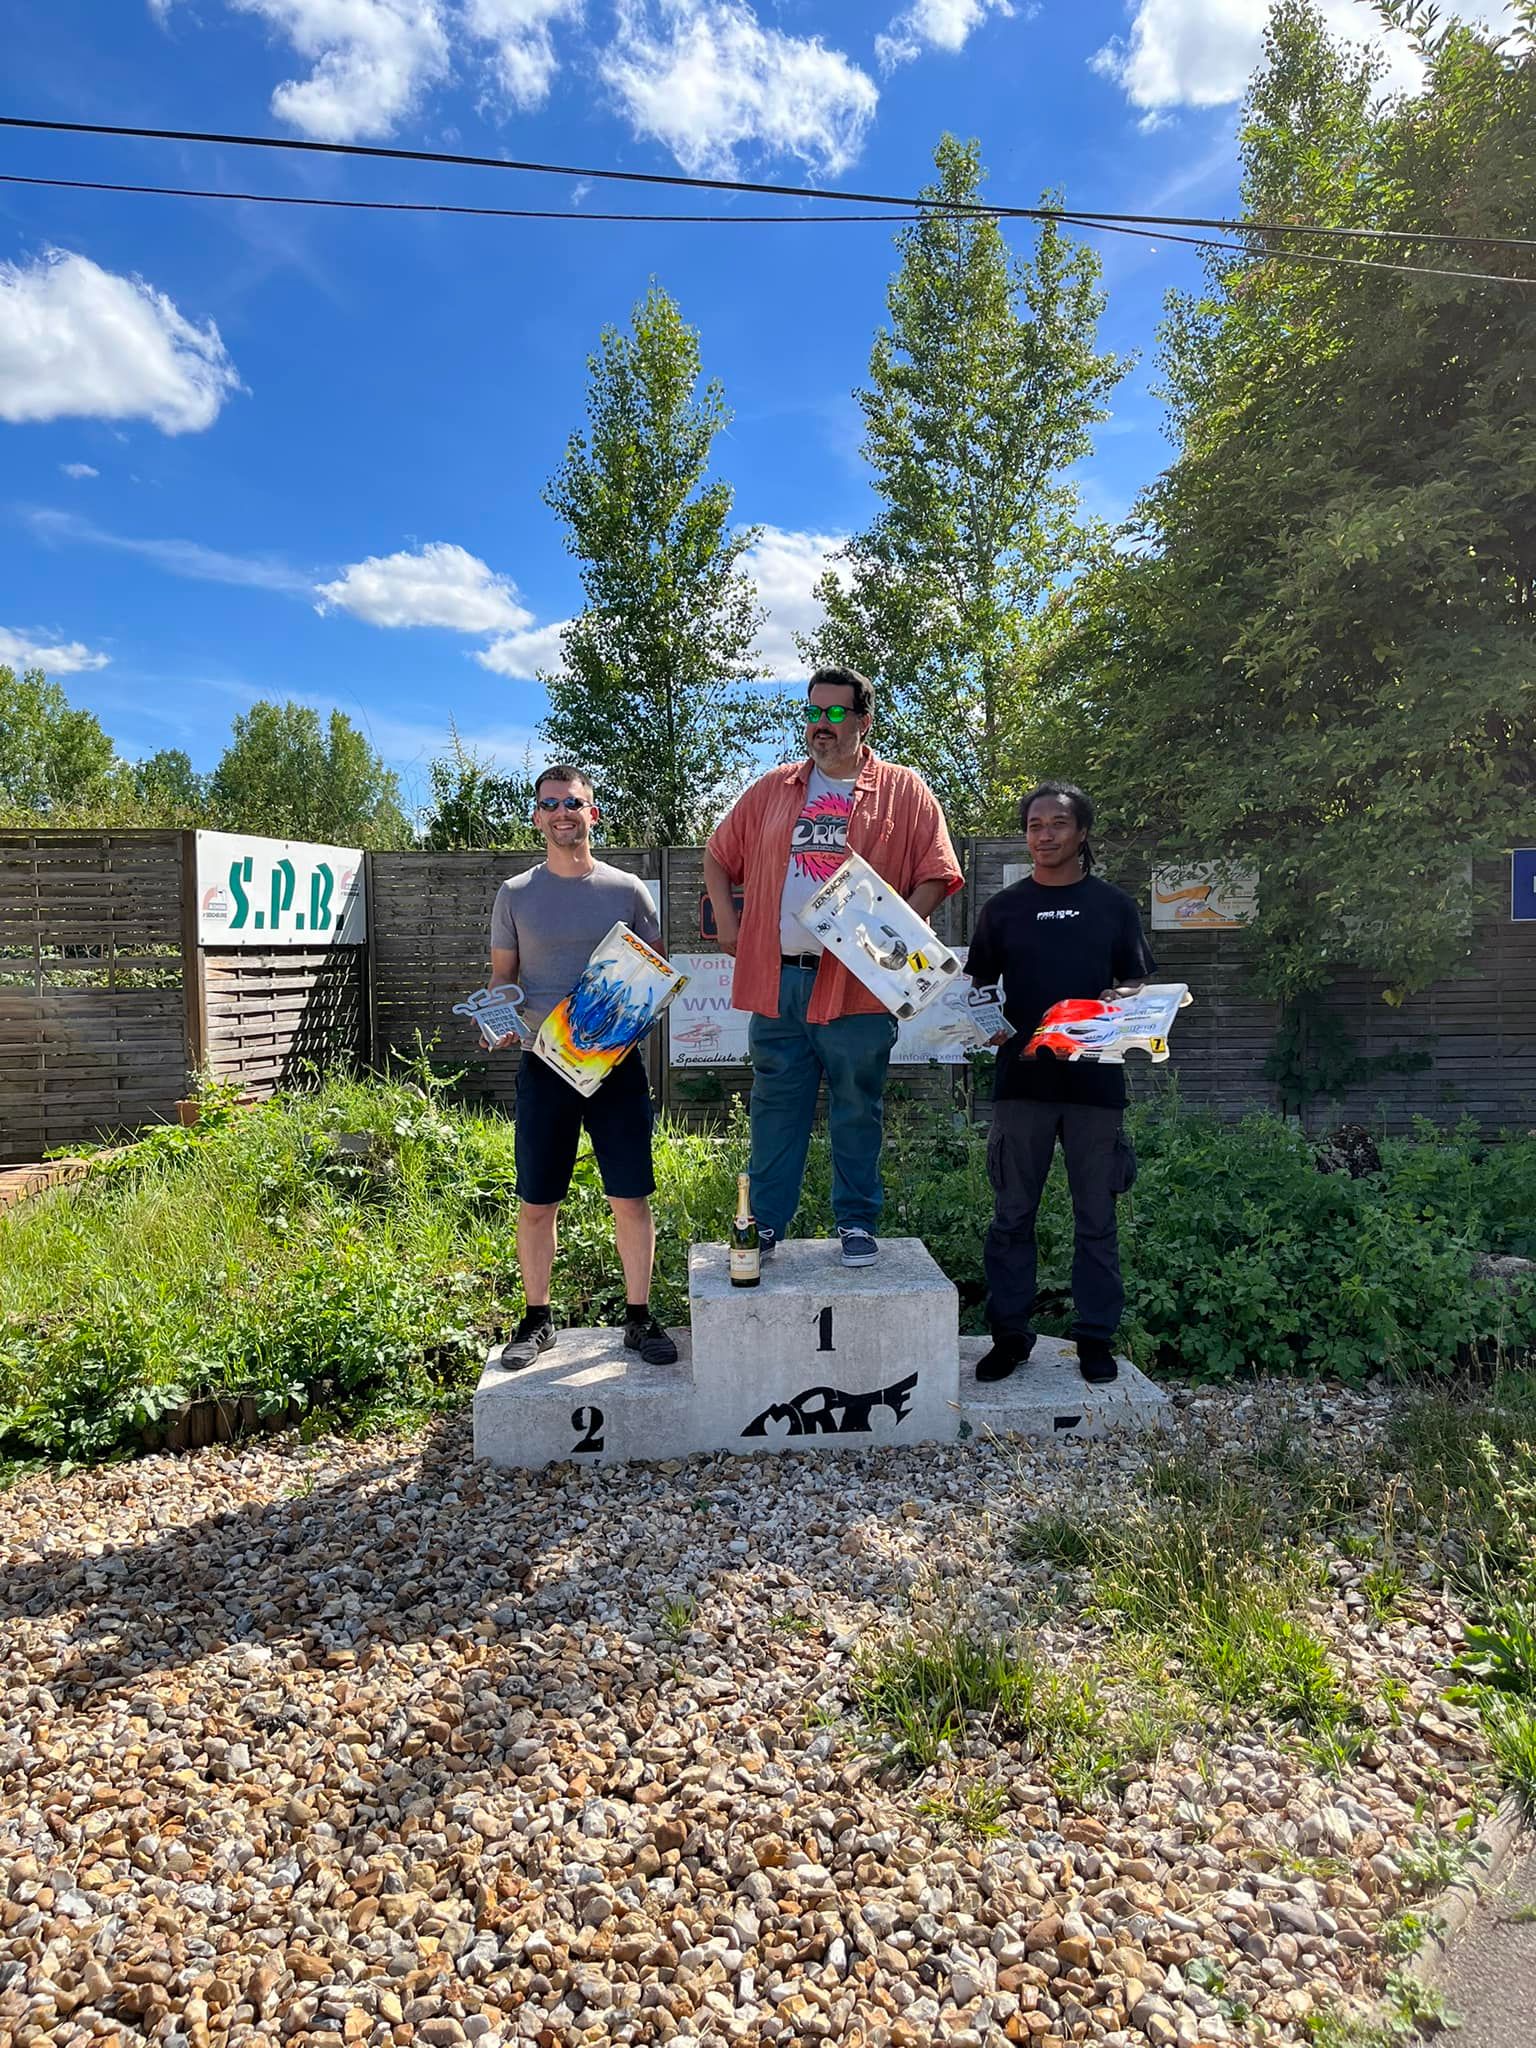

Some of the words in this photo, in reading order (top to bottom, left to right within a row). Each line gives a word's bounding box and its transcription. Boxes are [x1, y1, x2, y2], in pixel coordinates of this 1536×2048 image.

[229, 856, 344, 931] S.P.B.
[1153, 1039, 1161, 1050] 7
[811, 1306, 836, 1352] 1
[571, 1406, 604, 1453] 2
